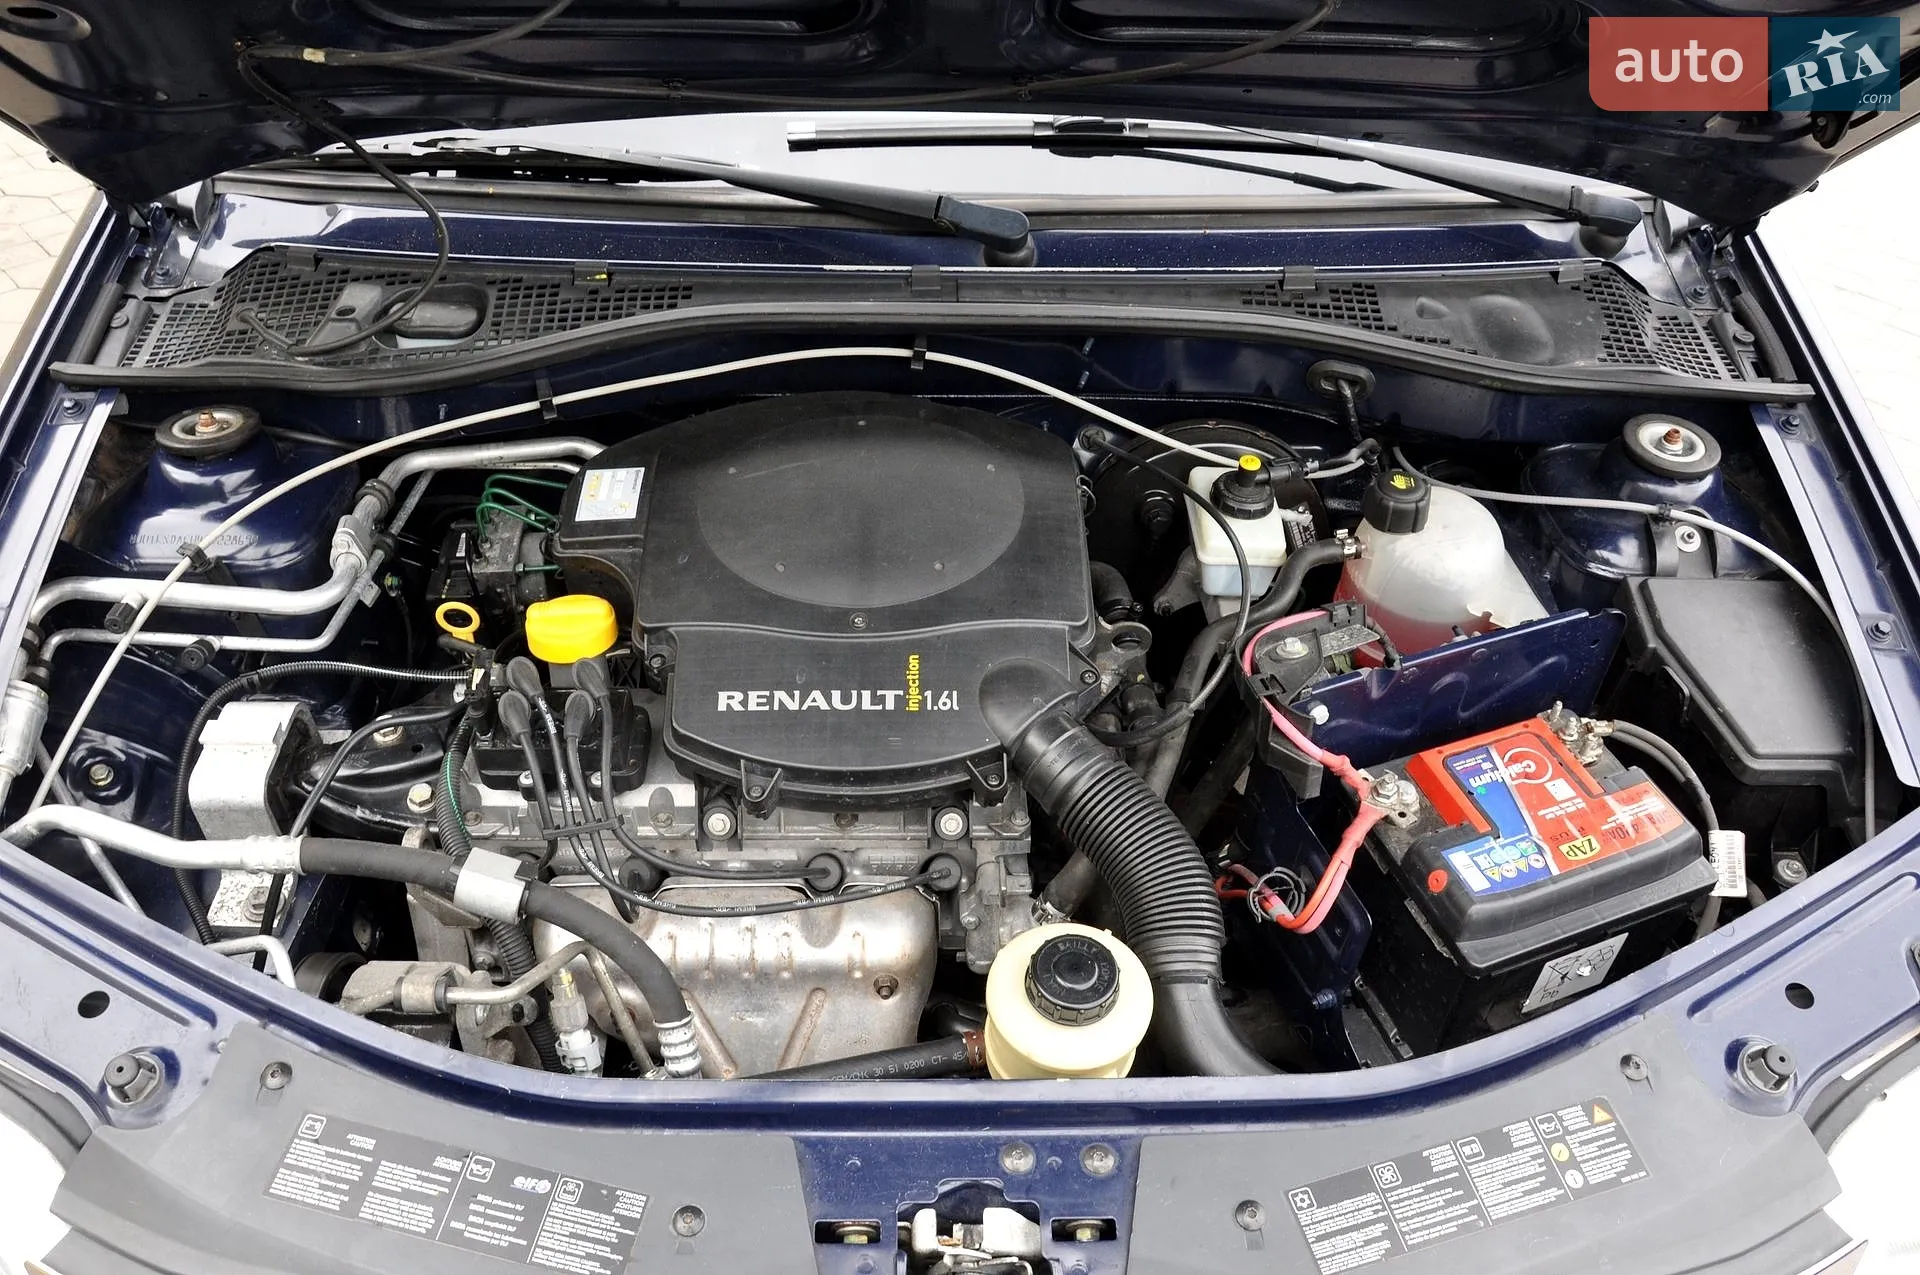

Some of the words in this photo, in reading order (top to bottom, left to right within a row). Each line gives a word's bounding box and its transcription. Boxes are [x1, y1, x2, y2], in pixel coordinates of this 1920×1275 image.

[717, 689, 904, 712] RENAULT
[905, 654, 921, 711] injection
[1565, 838, 1598, 859] ZAP
